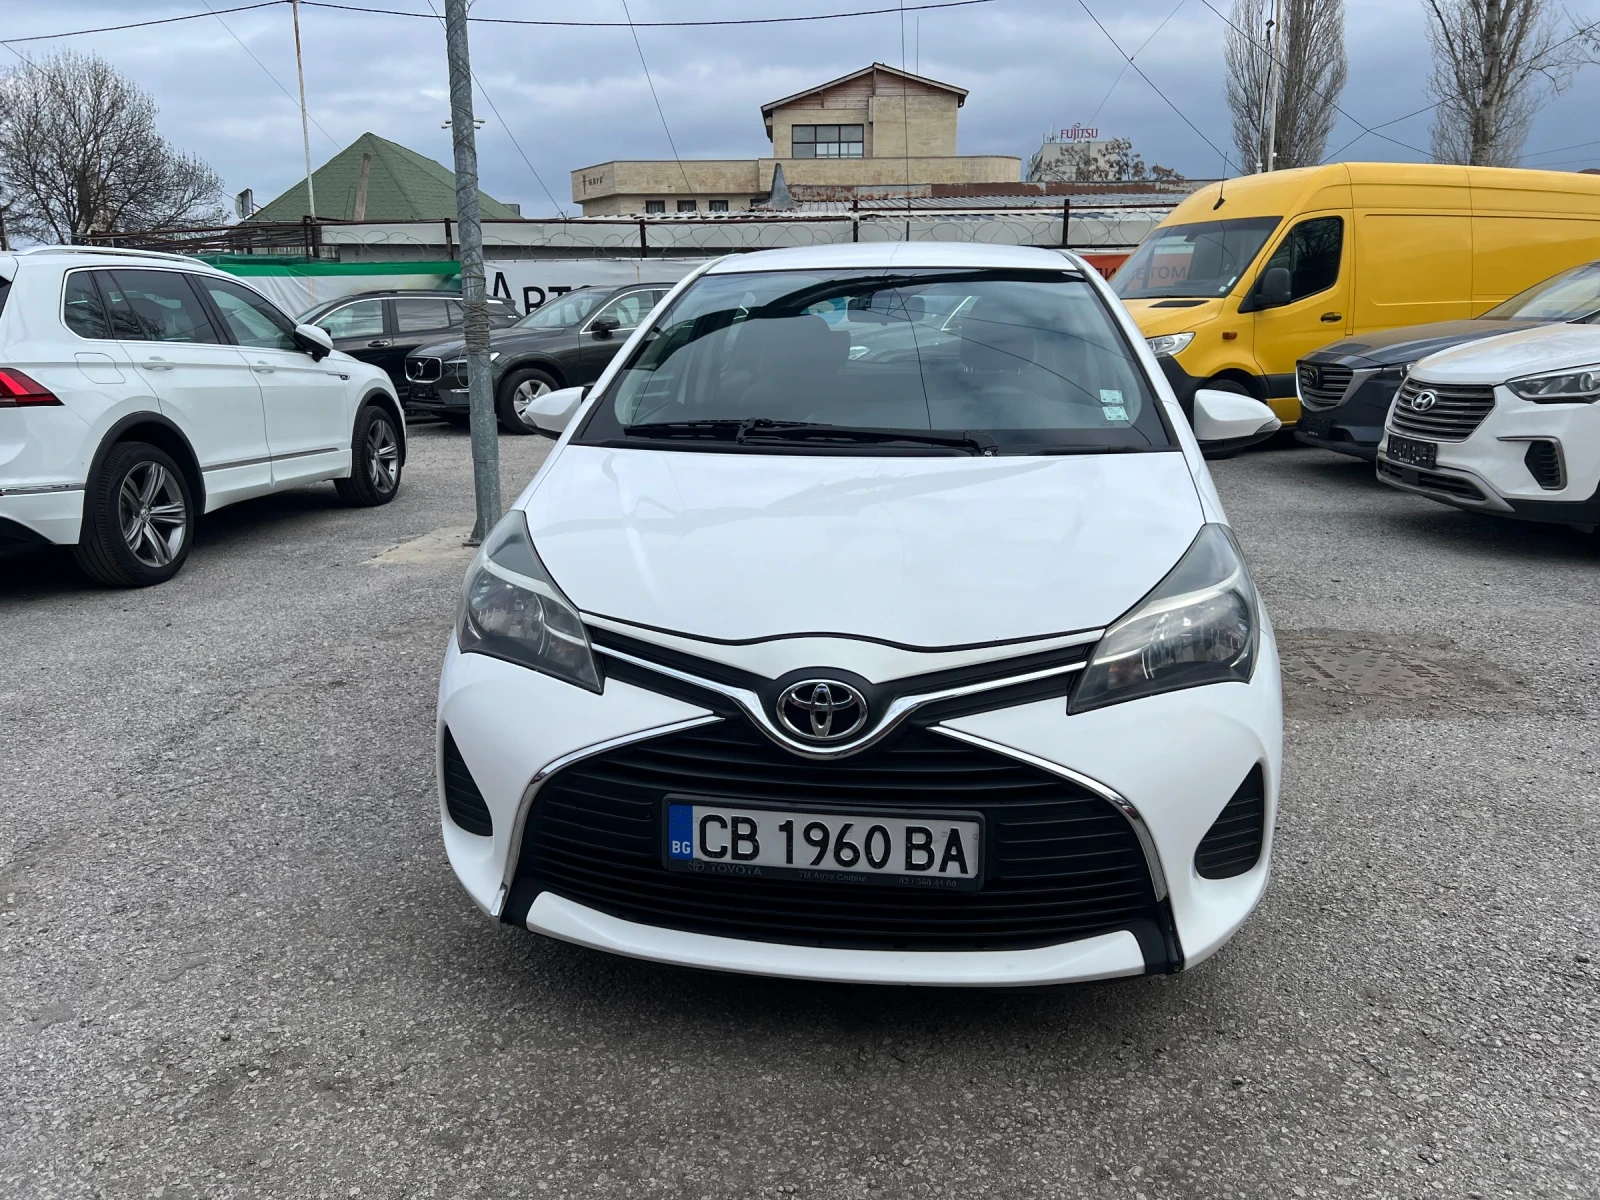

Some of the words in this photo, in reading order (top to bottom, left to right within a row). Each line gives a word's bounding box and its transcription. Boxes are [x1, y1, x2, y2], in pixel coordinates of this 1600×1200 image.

[1060, 122, 1098, 140] FUJITSU
[672, 841, 691, 855] BG
[699, 813, 761, 861] CB
[778, 819, 892, 870] 1960
[904, 825, 969, 875] BA
[709, 863, 762, 876] TOYOTA
[836, 873, 868, 884] София
